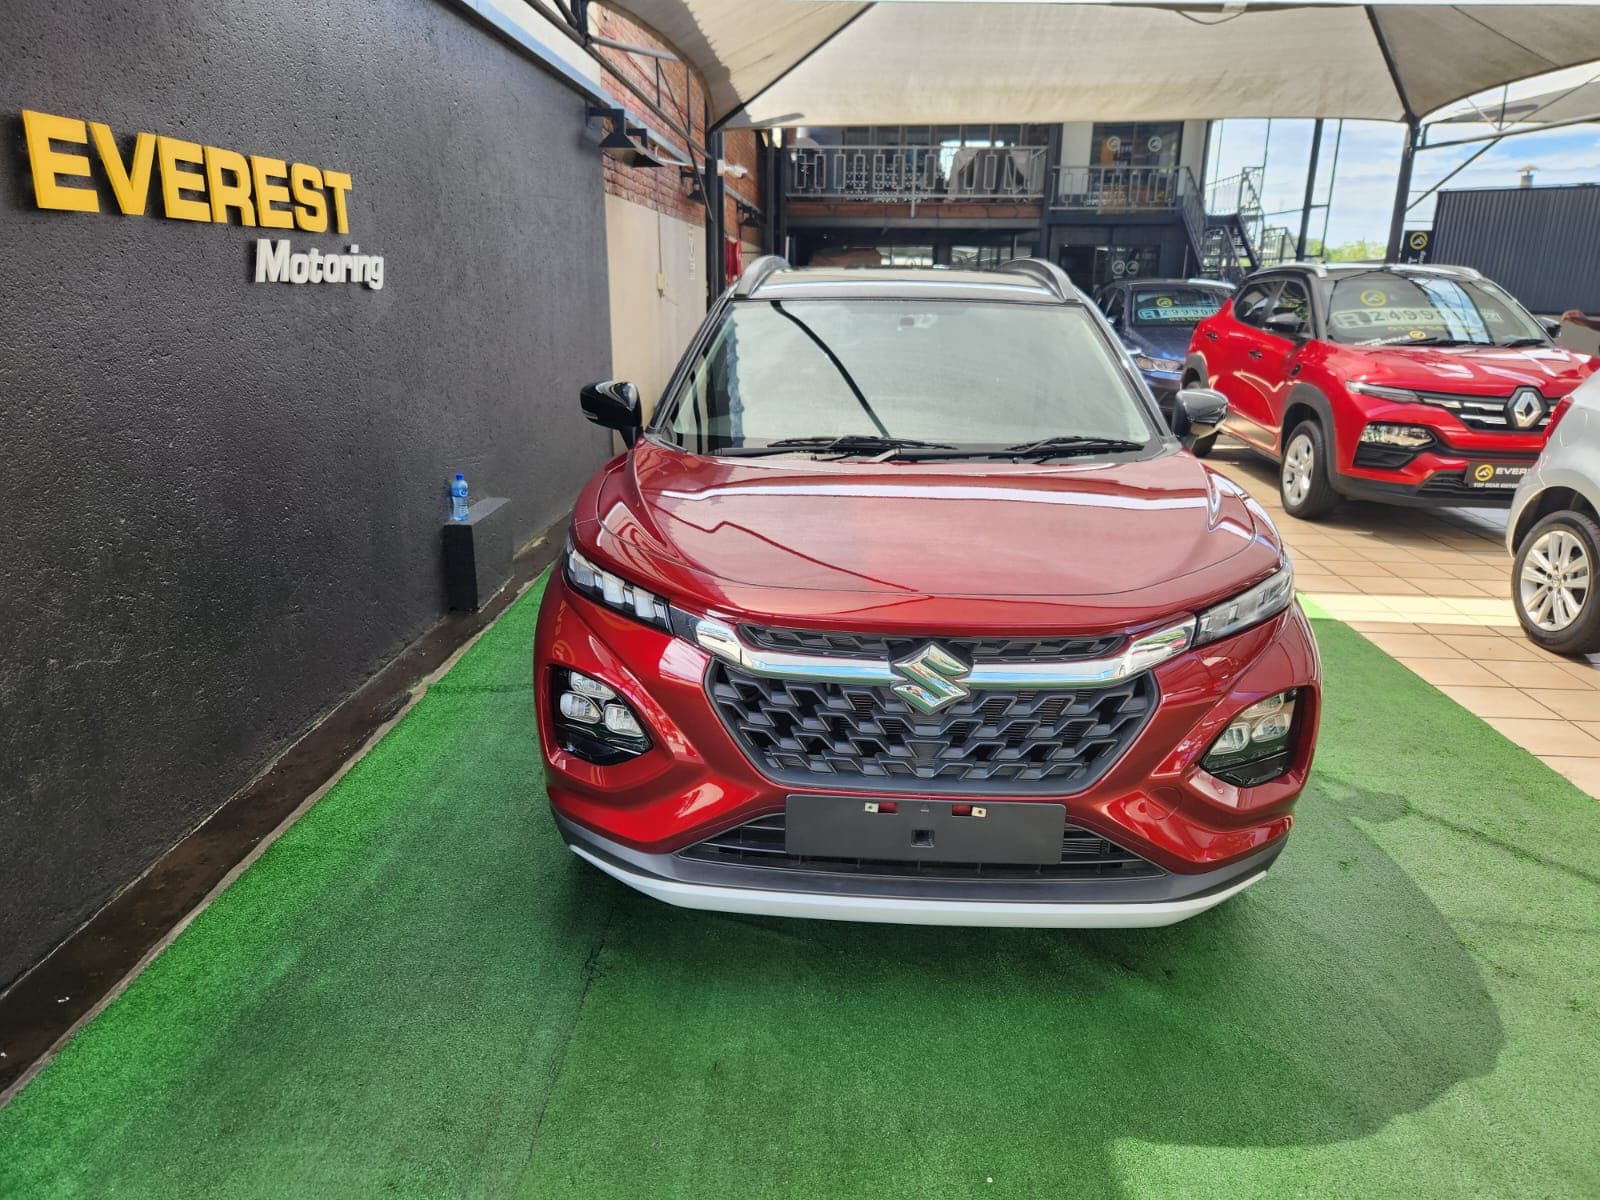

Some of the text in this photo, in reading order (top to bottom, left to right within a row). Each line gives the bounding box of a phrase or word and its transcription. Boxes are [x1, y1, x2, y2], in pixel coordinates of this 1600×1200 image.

[22, 109, 353, 234] EVEREST
[255, 238, 384, 289] Motoring
[1495, 466, 1531, 475] EVER
